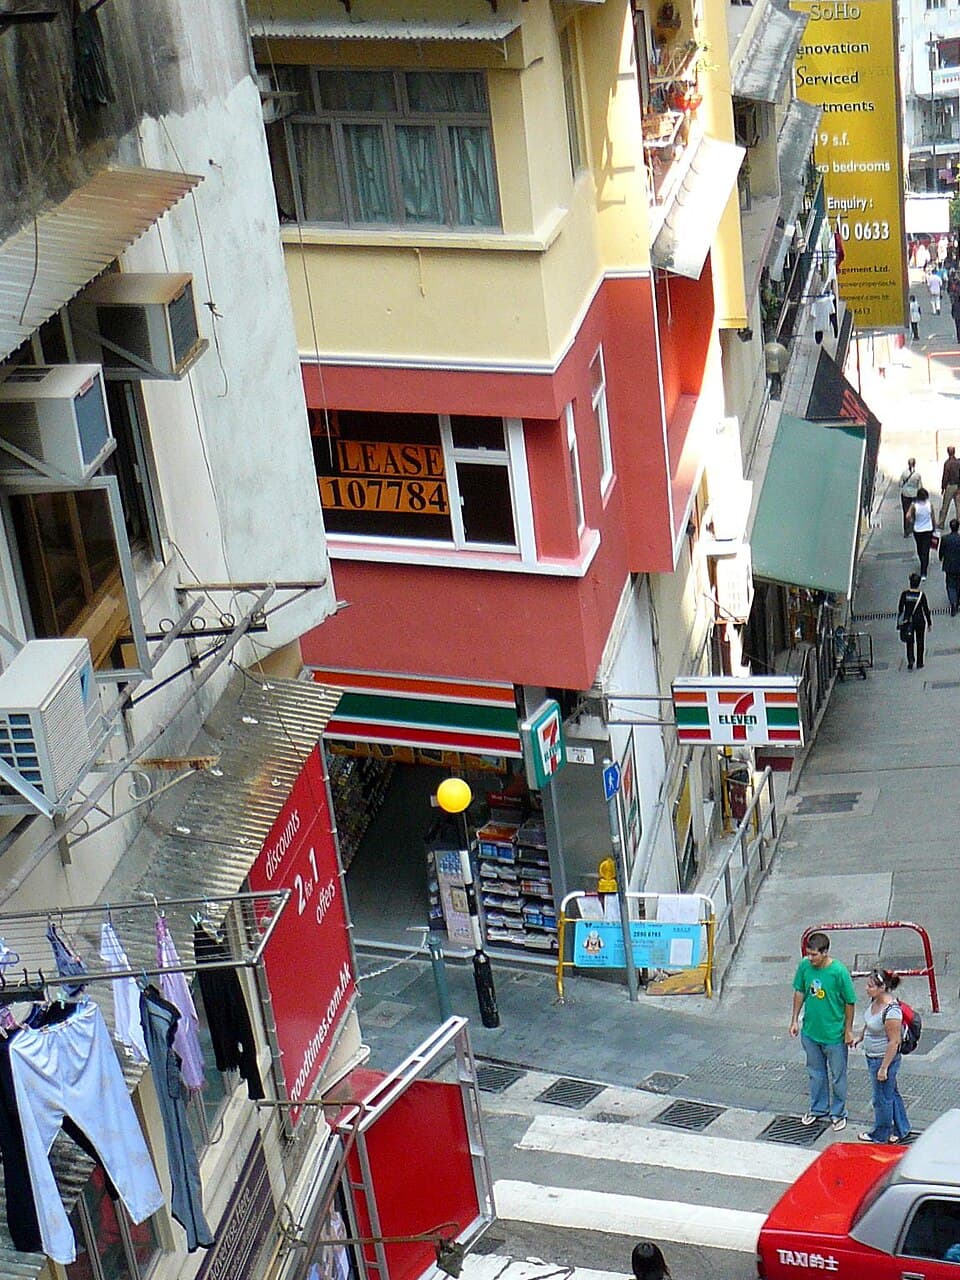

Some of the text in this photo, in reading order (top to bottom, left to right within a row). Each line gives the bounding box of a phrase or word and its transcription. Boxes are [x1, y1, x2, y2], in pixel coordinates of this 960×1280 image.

[810, 2, 861, 21] SoHo
[797, 42, 869, 57] enovation
[796, 66, 859, 88] Serviced
[816, 101, 874, 113] tments
[814, 133, 828, 146] 19
[833, 160, 890, 173] bedrooms
[827, 196, 866, 213] Enquiry
[854, 221, 890, 240] 0633
[839, 266, 872, 276] gement
[339, 442, 444, 477] LEASE
[321, 479, 448, 512] 107784
[265, 808, 300, 881] discounts
[294, 873, 306, 916] 2
[309, 847, 319, 882] 1
[315, 878, 335, 925] offers
[777, 1249, 808, 1268] TAXI
